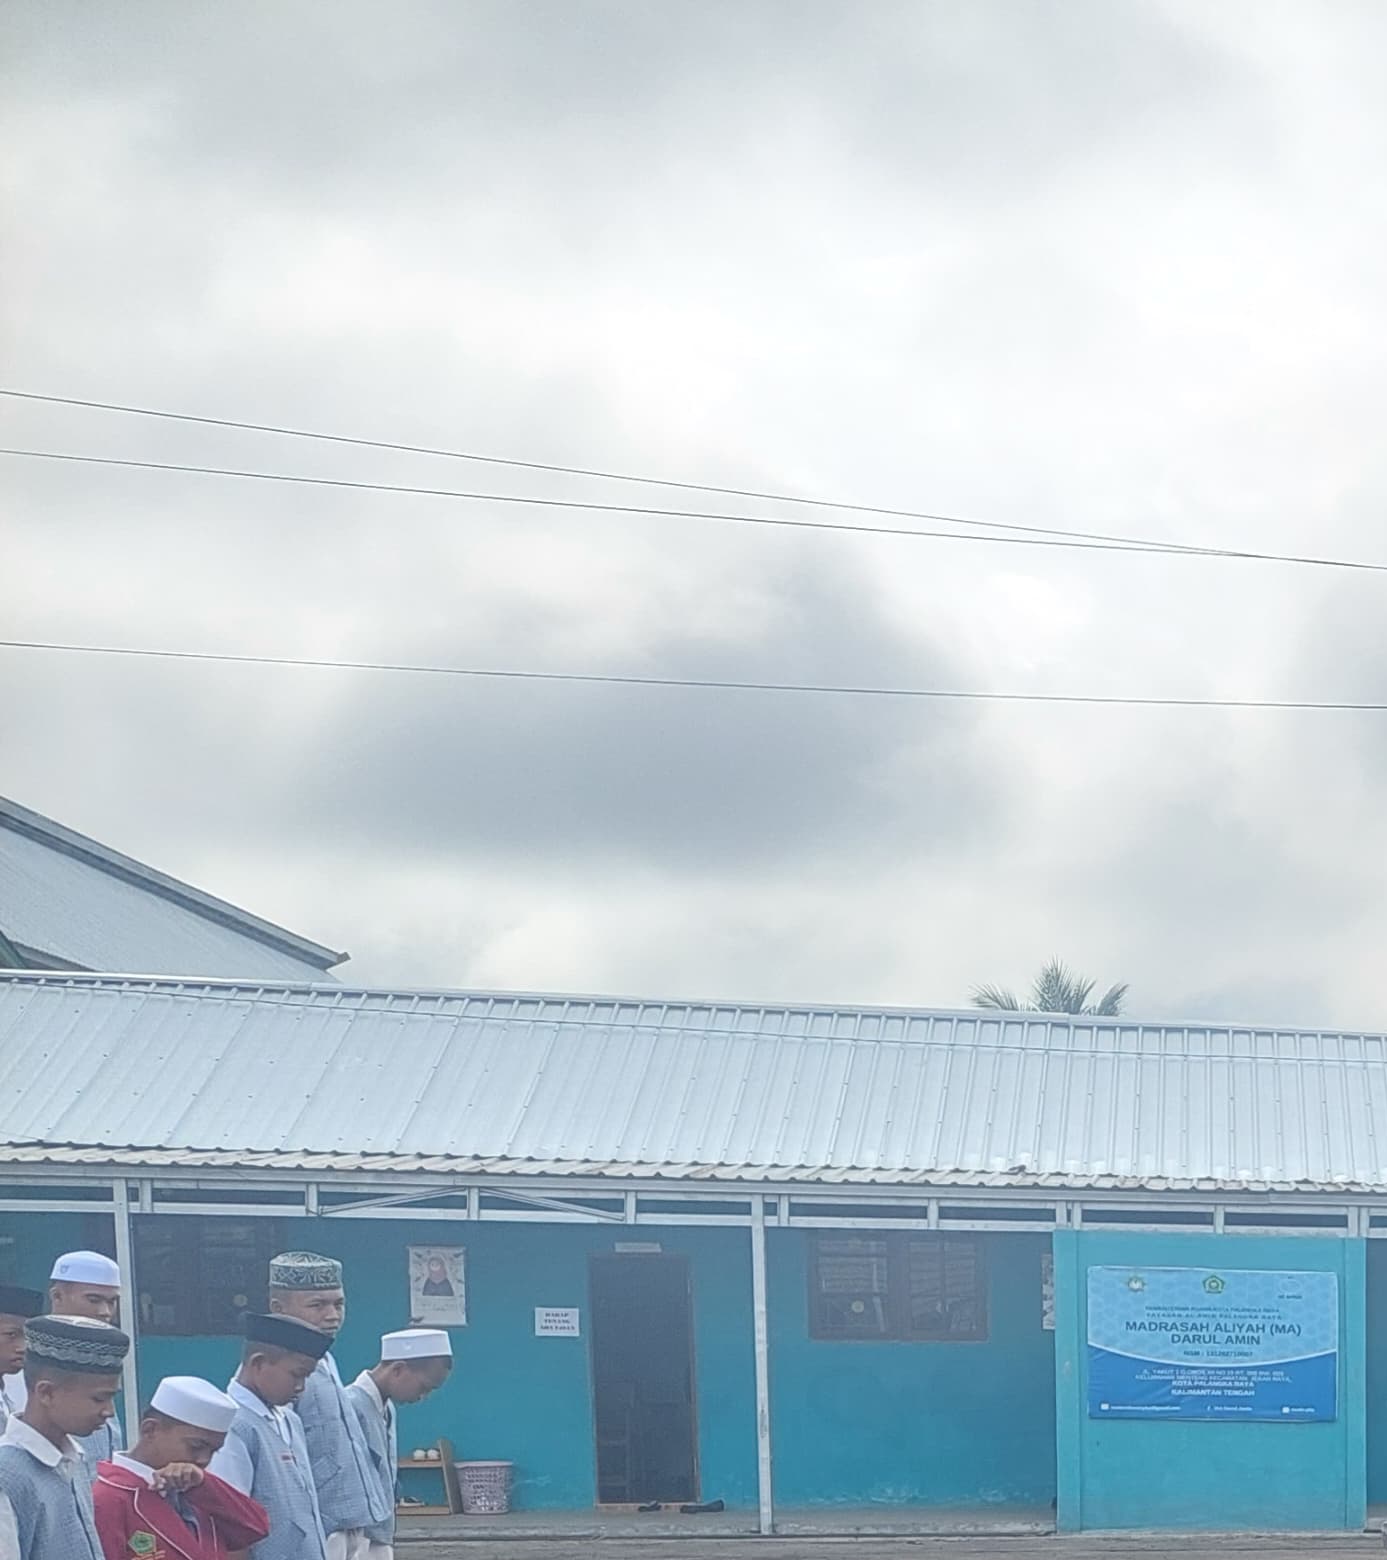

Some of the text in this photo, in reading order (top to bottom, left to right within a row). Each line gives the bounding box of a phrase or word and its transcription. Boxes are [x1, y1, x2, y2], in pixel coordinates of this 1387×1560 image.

[1125, 1320, 1302, 1337] MADRASAH ALIYAH (MA)
[1170, 1333, 1261, 1346] DARUL AMIN
